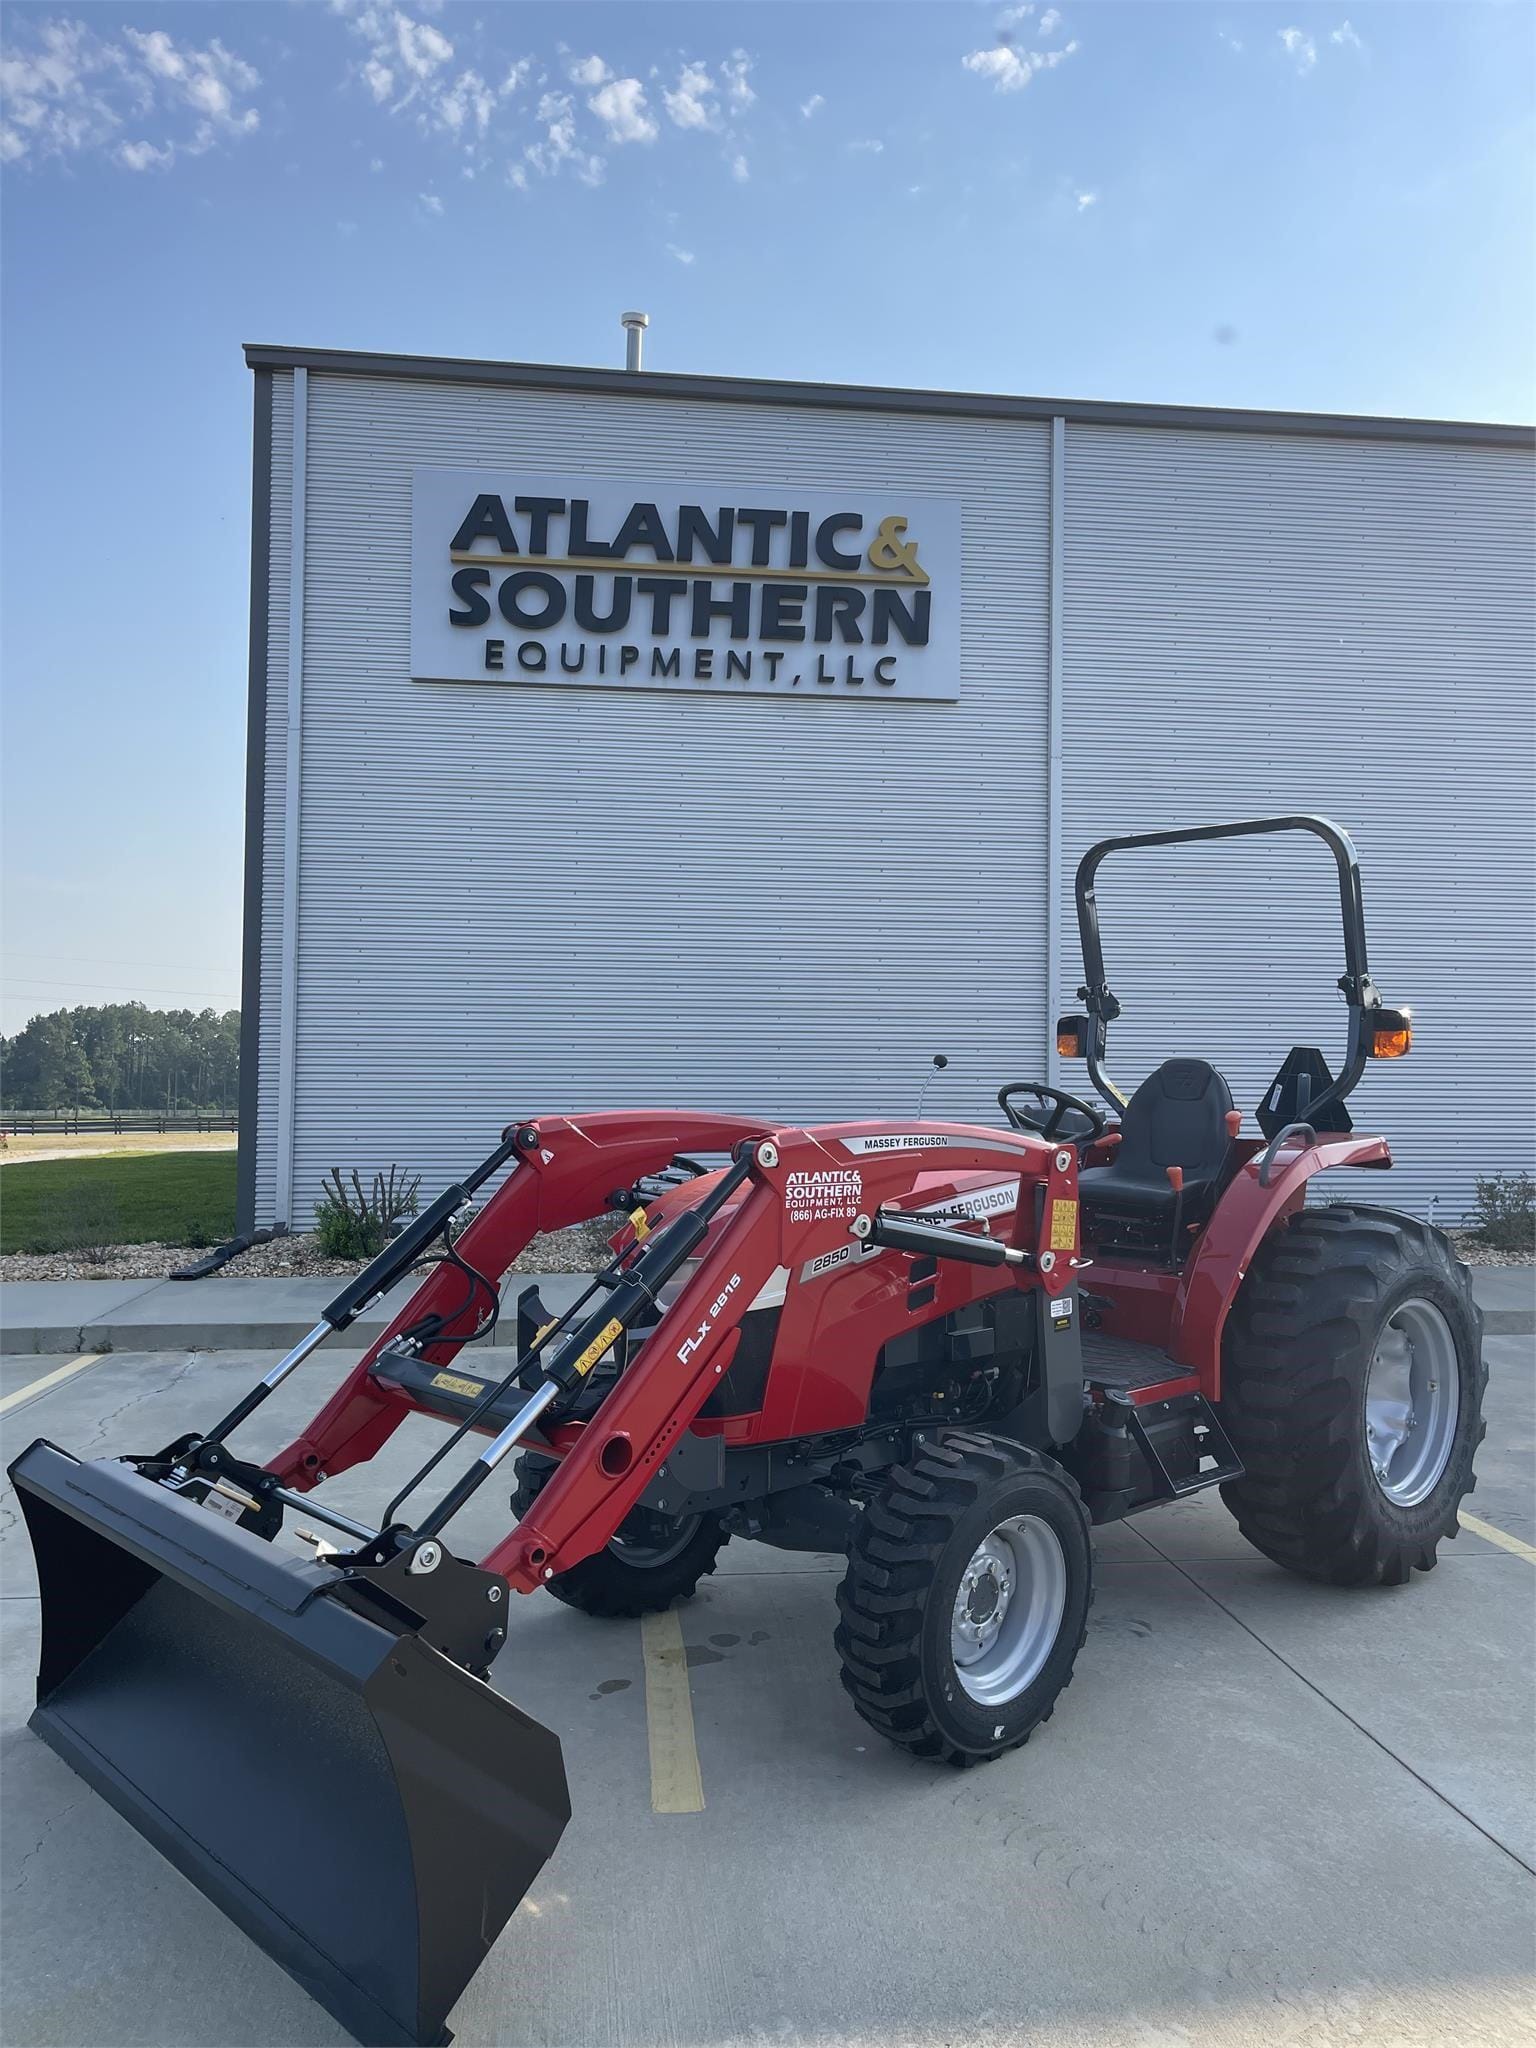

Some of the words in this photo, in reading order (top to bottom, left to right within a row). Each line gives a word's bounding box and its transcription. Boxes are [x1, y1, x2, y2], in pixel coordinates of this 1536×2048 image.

[449, 568, 931, 645] SOUTHERN
[817, 654, 897, 686] LLC
[864, 1138, 901, 1149] MASSEY
[903, 1137, 948, 1147] FERGUSON
[785, 1185, 862, 1199] SOUTHERN
[785, 1198, 843, 1209] EQUIPMENT,
[847, 1196, 862, 1205] LLC
[790, 1209, 812, 1223] (866)
[814, 1208, 845, 1219] AG-FIX
[846, 1207, 857, 1218] 89
[813, 1247, 849, 1272] 2850
[709, 1273, 741, 1318] 2815
